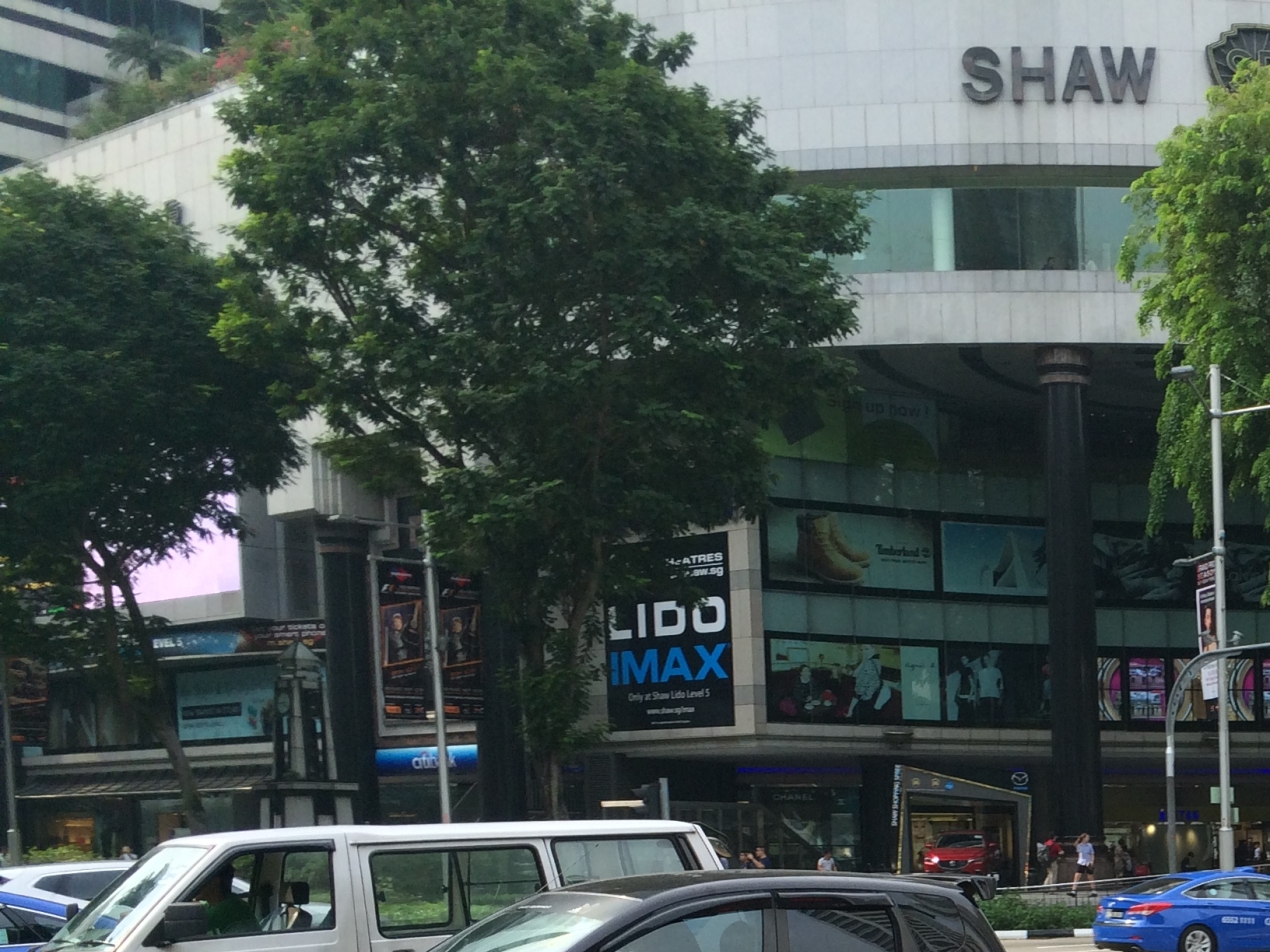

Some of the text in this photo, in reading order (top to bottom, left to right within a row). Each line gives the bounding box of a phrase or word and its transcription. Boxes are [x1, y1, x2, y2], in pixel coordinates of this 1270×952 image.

[961, 45, 1157, 105] SHAW
[607, 596, 726, 640] LIDO
[610, 642, 729, 686] IMAX
[627, 688, 711, 703] Only at Shaw Lido Level 5
